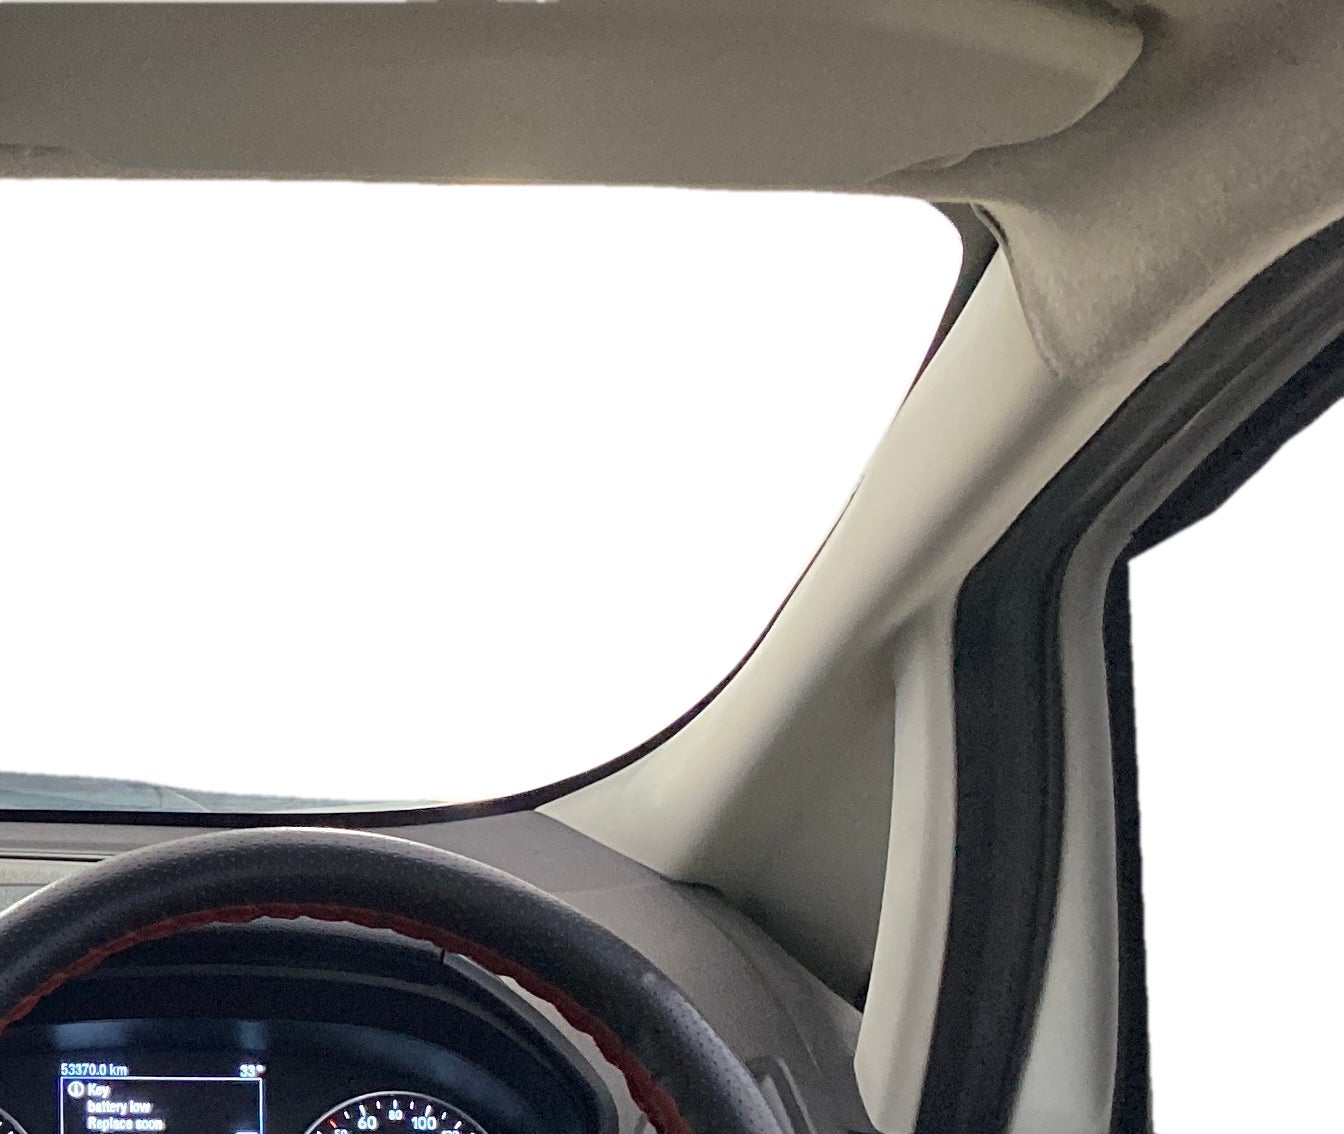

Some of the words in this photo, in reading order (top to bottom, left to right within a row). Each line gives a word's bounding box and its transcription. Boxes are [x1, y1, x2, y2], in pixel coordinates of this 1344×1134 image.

[60, 1062, 107, 1076] 53370.0
[109, 1063, 128, 1076] km
[87, 1082, 111, 1098] Key
[87, 1099, 128, 1115] battery
[388, 1110, 403, 1121] 80
[87, 1116, 133, 1132] Replace
[135, 1119, 166, 1131] soon
[357, 1116, 378, 1130] 60
[411, 1116, 437, 1130] 100
